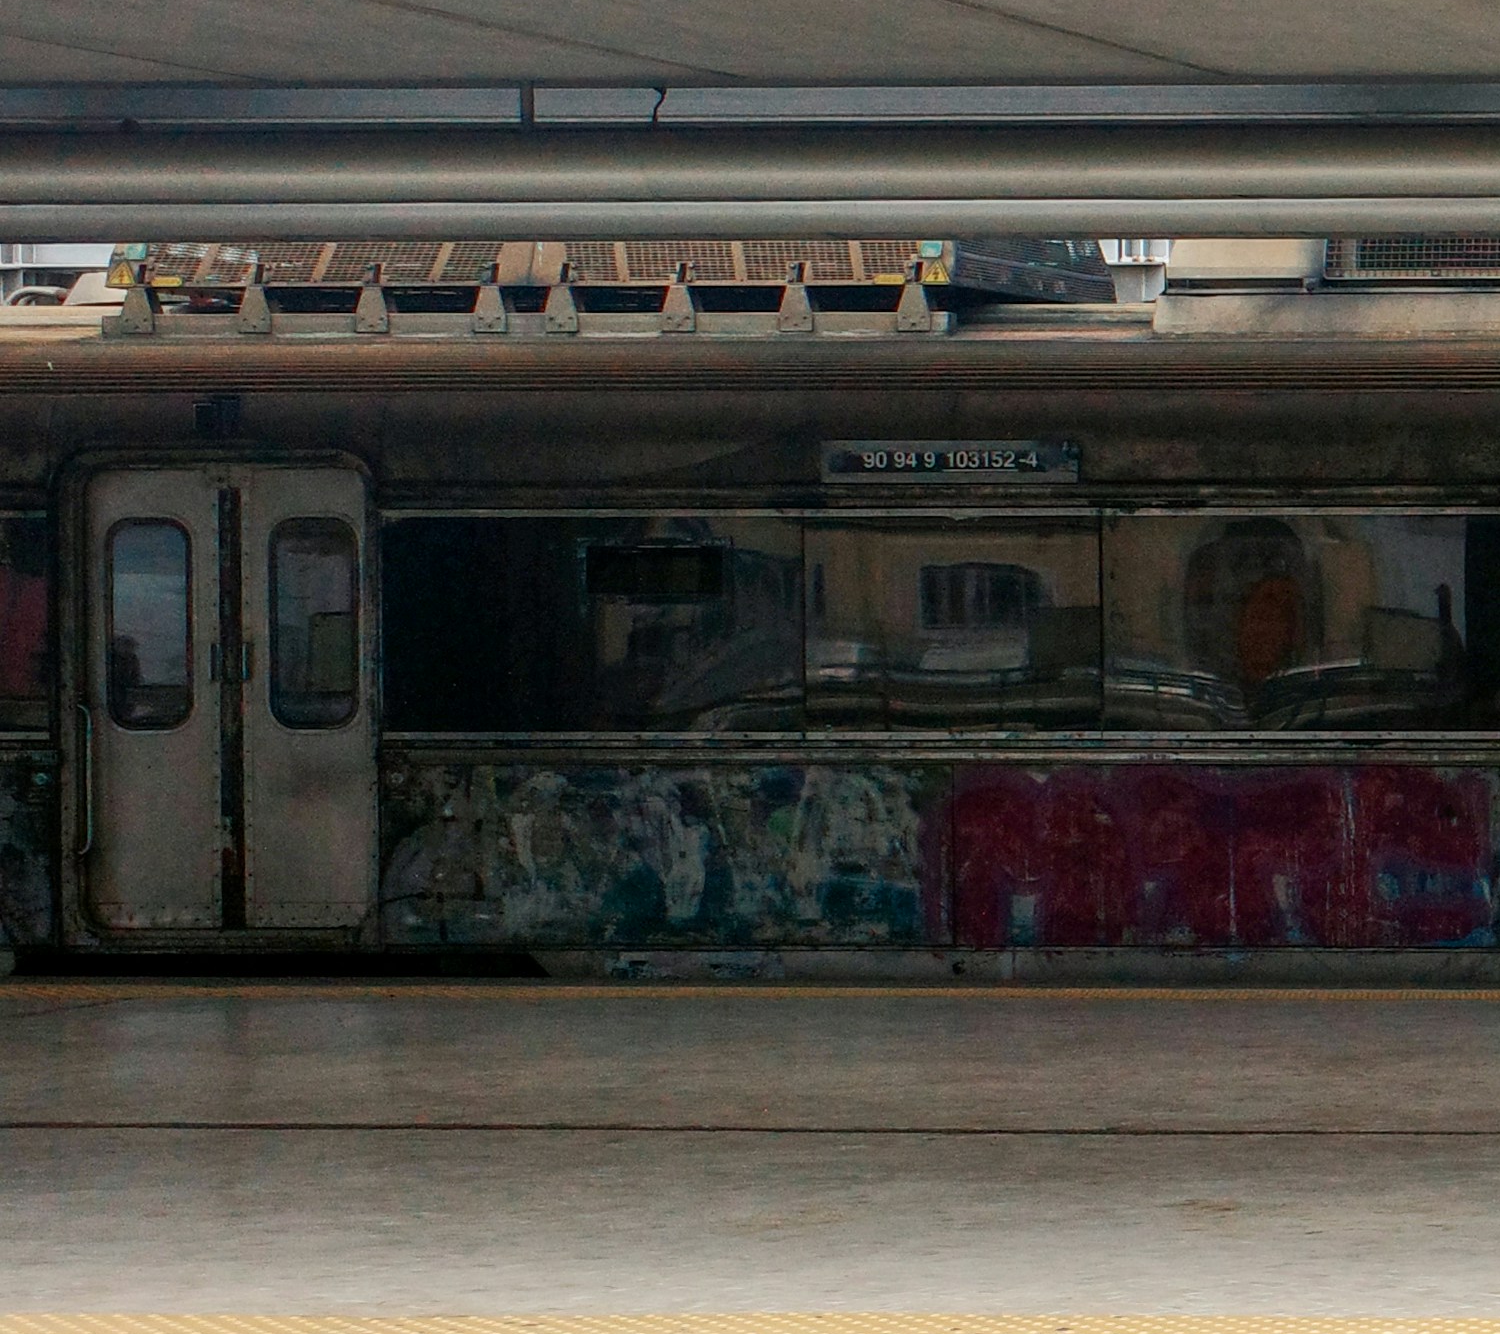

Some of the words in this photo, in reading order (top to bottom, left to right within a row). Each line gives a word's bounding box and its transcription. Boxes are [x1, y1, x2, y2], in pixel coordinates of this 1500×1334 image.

[862, 451, 888, 469] 90
[893, 451, 918, 469] 94
[923, 451, 936, 469] 9
